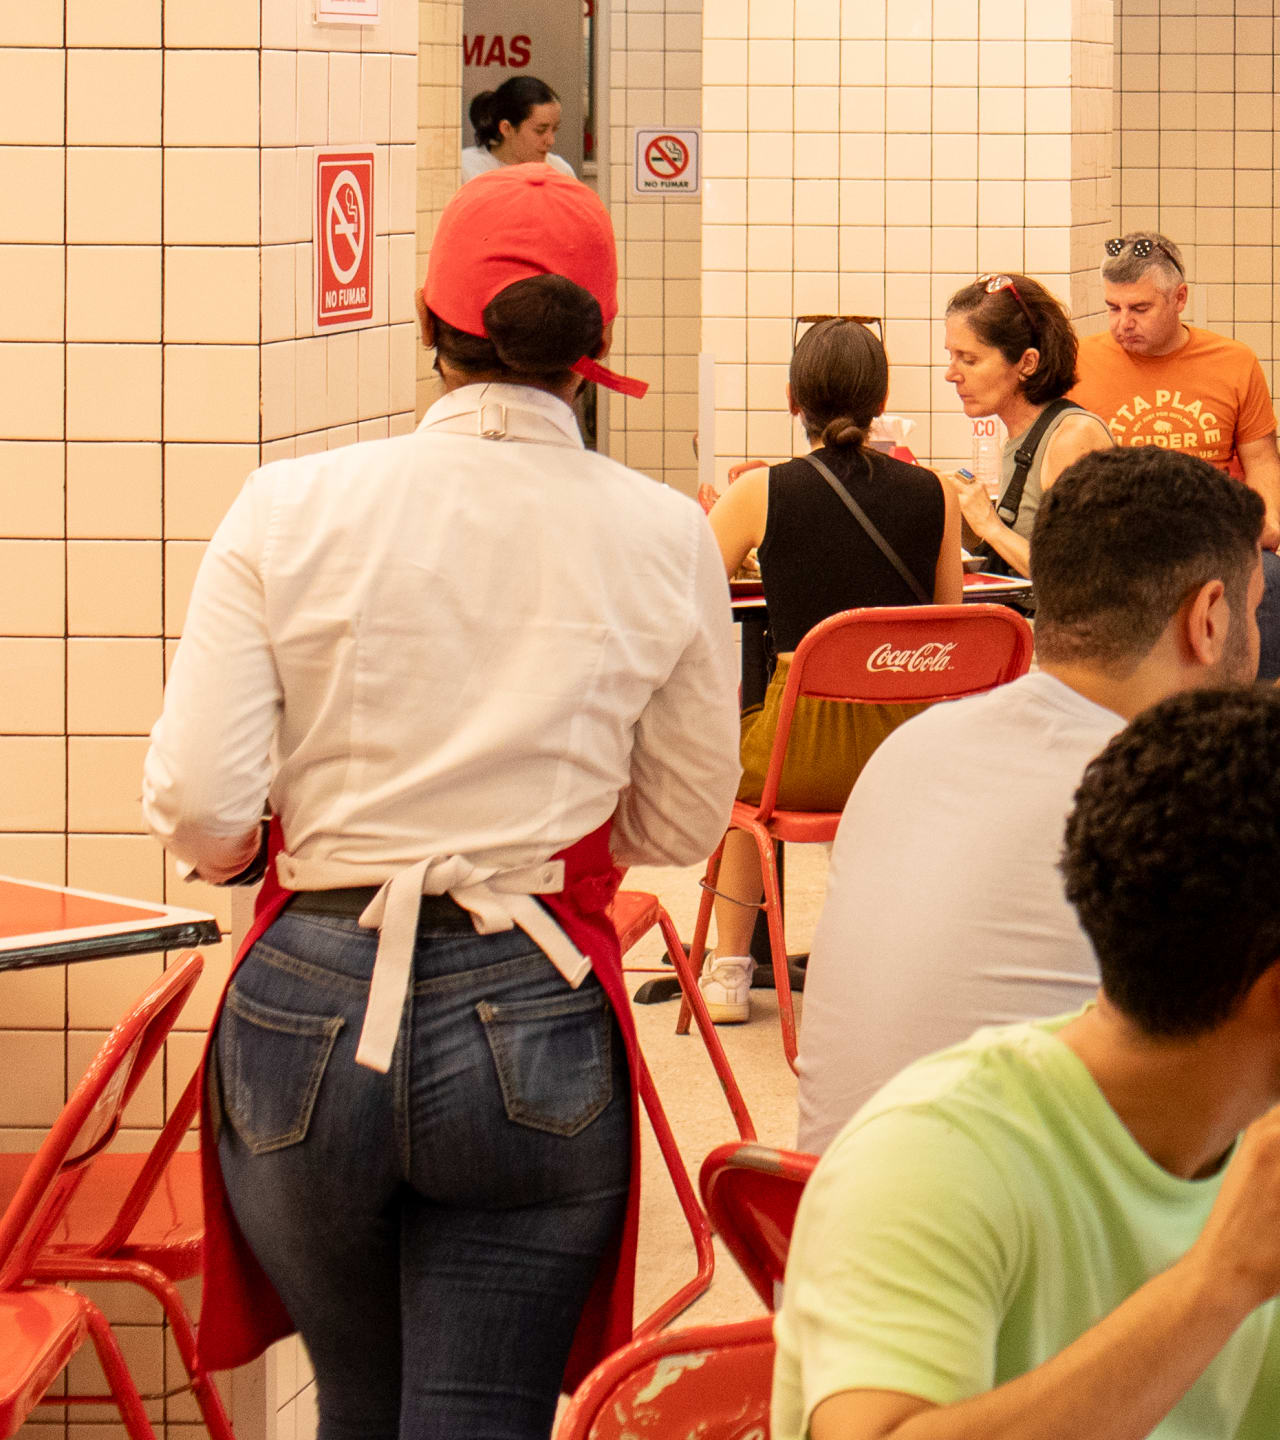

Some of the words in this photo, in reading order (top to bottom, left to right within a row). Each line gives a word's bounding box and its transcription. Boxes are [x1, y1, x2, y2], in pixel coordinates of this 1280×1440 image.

[661, 181, 688, 189] FUMAR
[326, 290, 337, 309] NO
[339, 286, 367, 307] FUMAR
[1155, 390, 1221, 445] PLACE
[1130, 432, 1198, 449] CIDER
[866, 642, 959, 672] Coca-Cola
